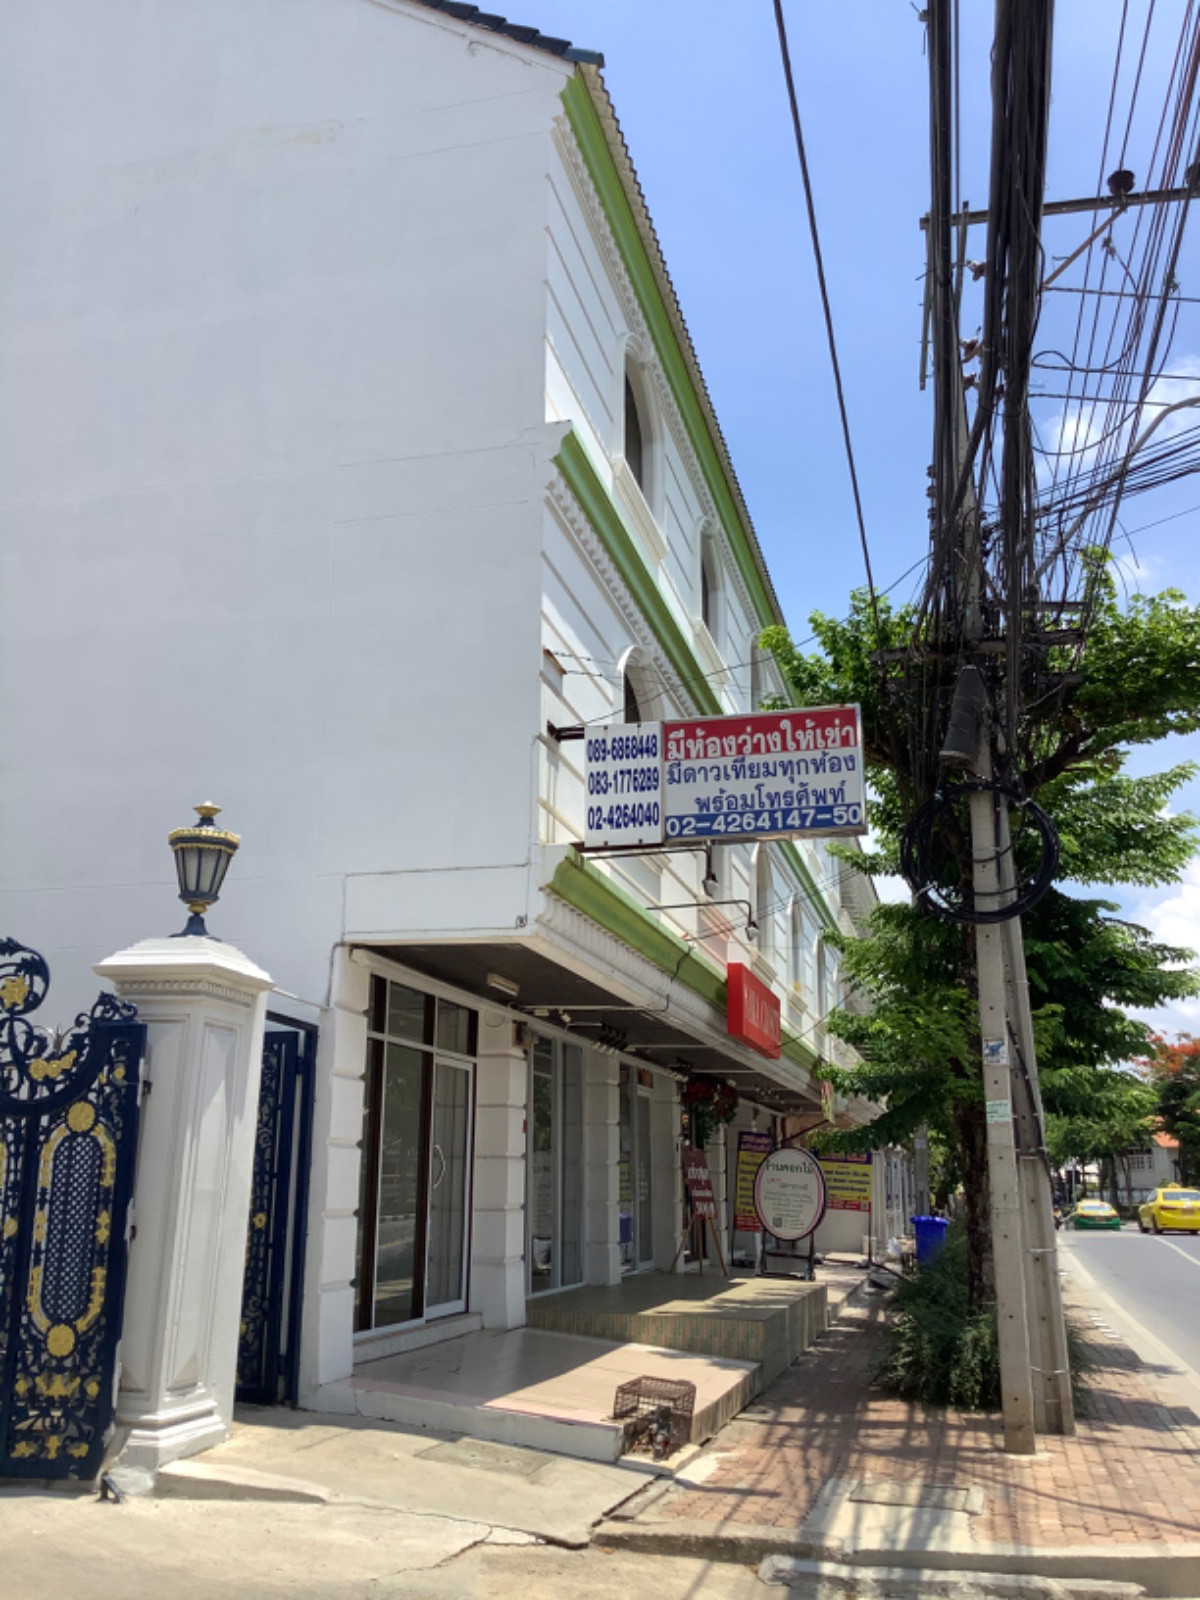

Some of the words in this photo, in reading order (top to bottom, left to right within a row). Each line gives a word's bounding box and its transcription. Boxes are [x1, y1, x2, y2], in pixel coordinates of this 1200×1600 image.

[667, 719, 856, 761] มีห้องว่างให้เช่า
[666, 753, 855, 785] มีดาวเทียมทุกห้อง
[666, 805, 862, 837] 02-4264147-50
